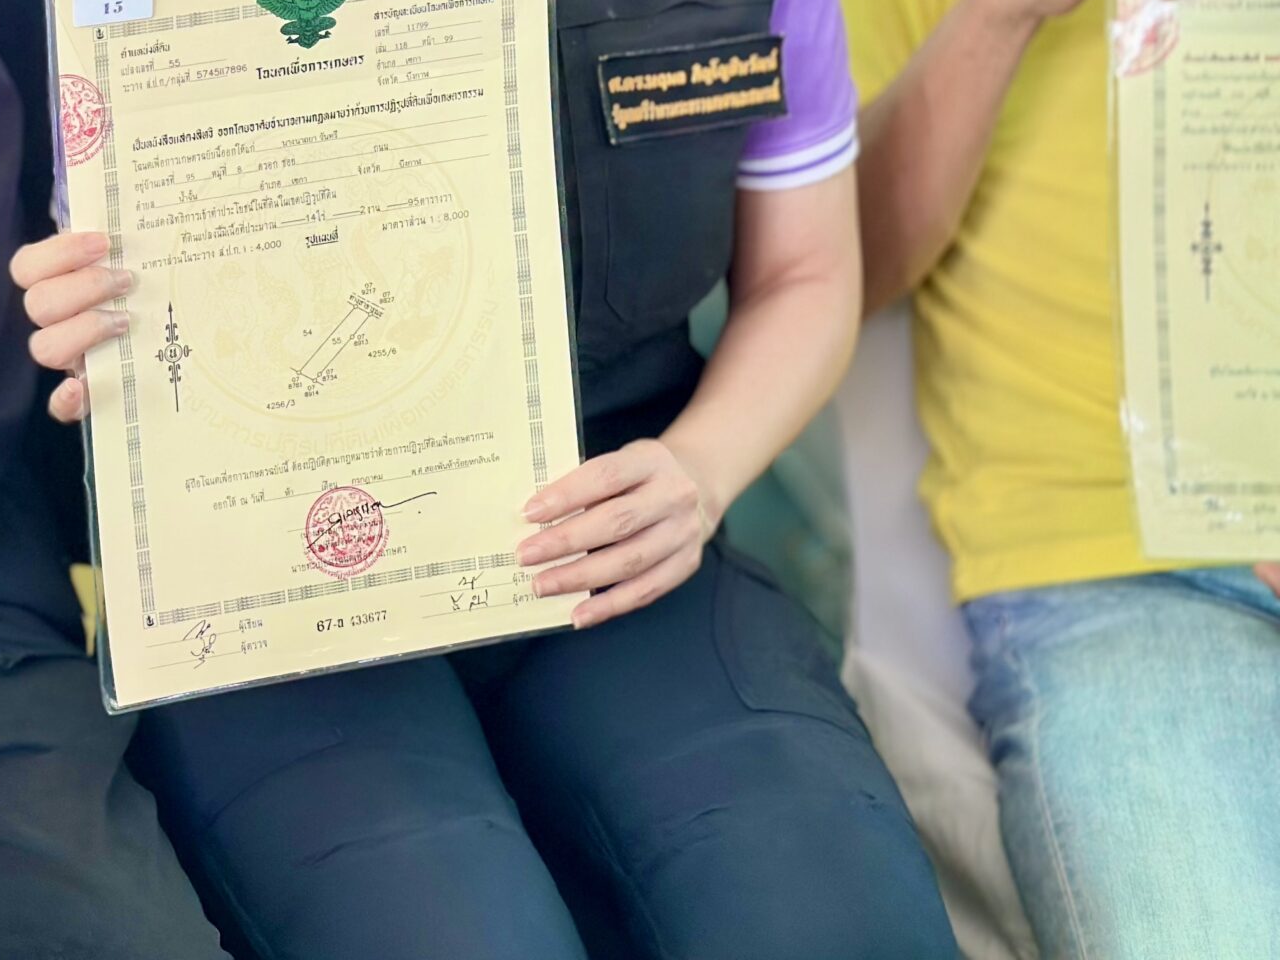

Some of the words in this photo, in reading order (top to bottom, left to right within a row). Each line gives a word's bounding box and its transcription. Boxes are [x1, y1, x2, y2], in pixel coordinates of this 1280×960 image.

[104, 0, 123, 15] 15
[120, 39, 170, 59] ตำแหน่งที่ดิน
[168, 58, 181, 69] 55
[255, 55, 365, 80] โฉนดเพื่อการเกษตร
[443, 209, 470, 222] 8,000
[255, 239, 282, 251] 4,000
[303, 328, 313, 337] 54
